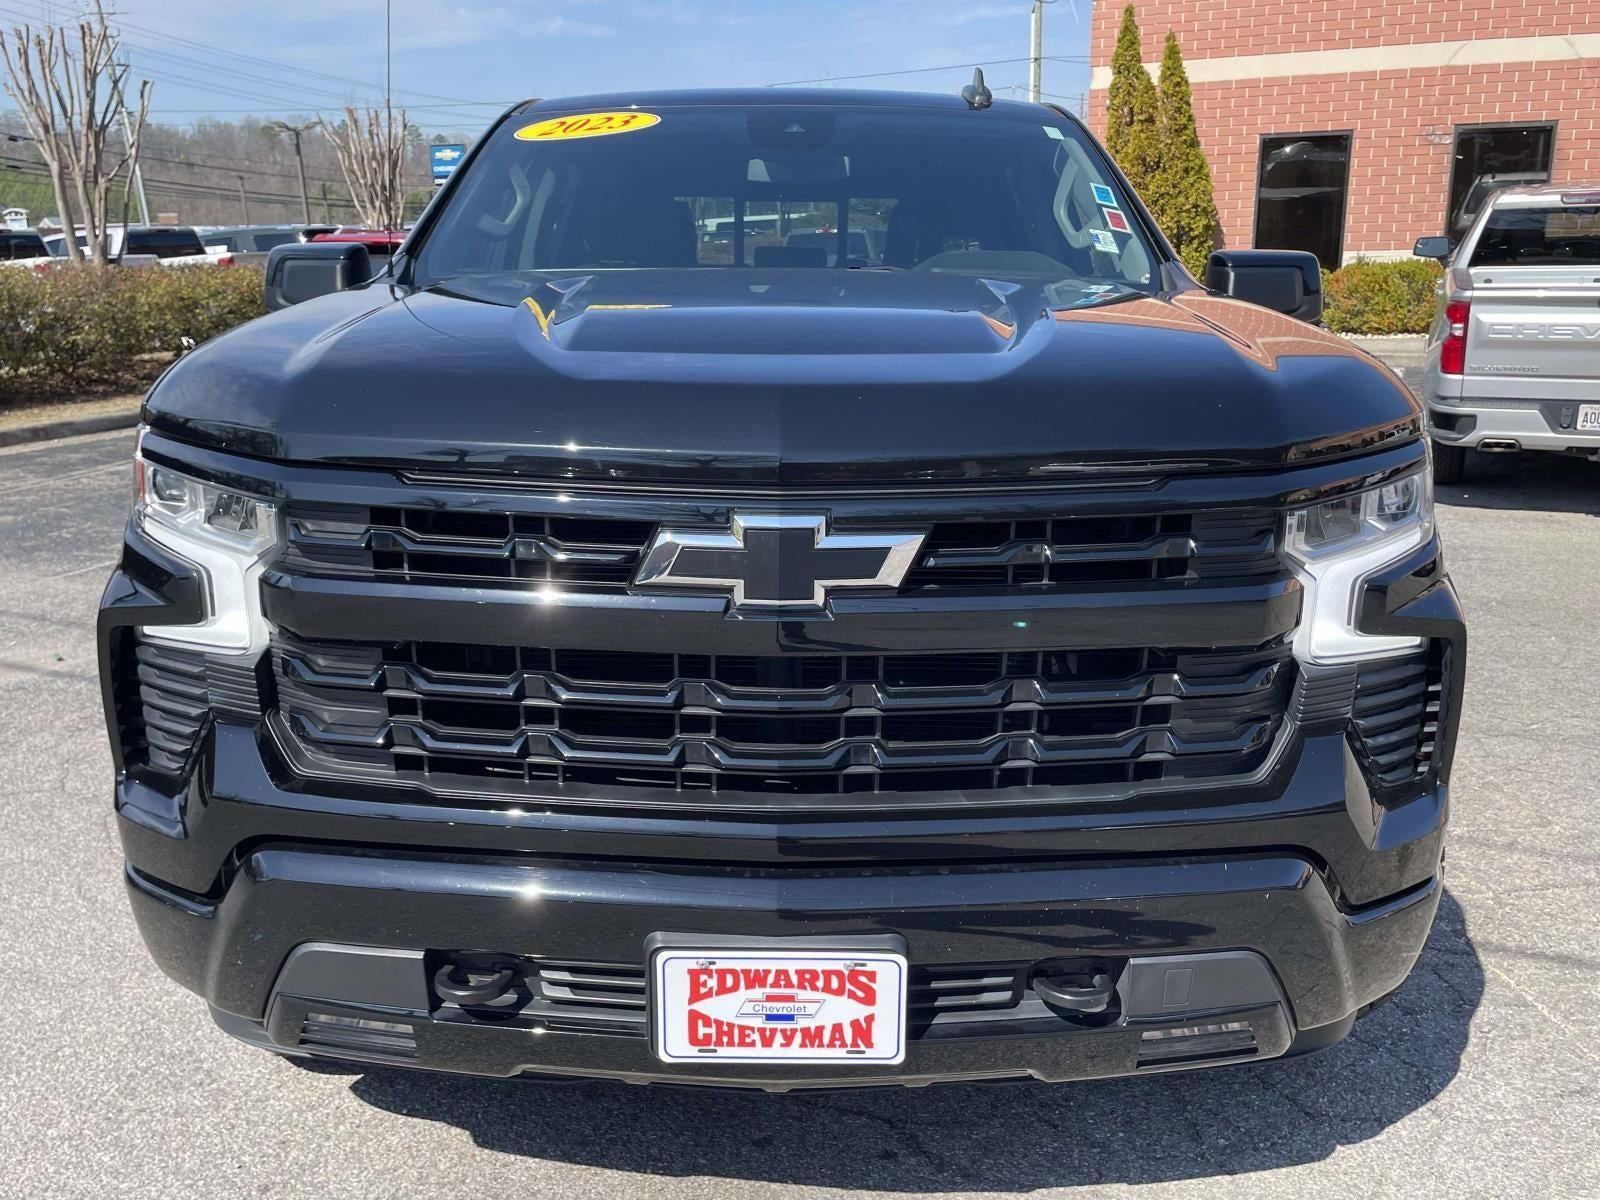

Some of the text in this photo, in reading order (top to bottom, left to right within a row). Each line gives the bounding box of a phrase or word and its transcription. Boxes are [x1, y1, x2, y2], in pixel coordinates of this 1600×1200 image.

[537, 115, 638, 137] 2023
[687, 968, 877, 1006] EDWARDS
[752, 1003, 807, 1013] Chevrolet
[688, 1008, 876, 1049] CHEVYMAN
